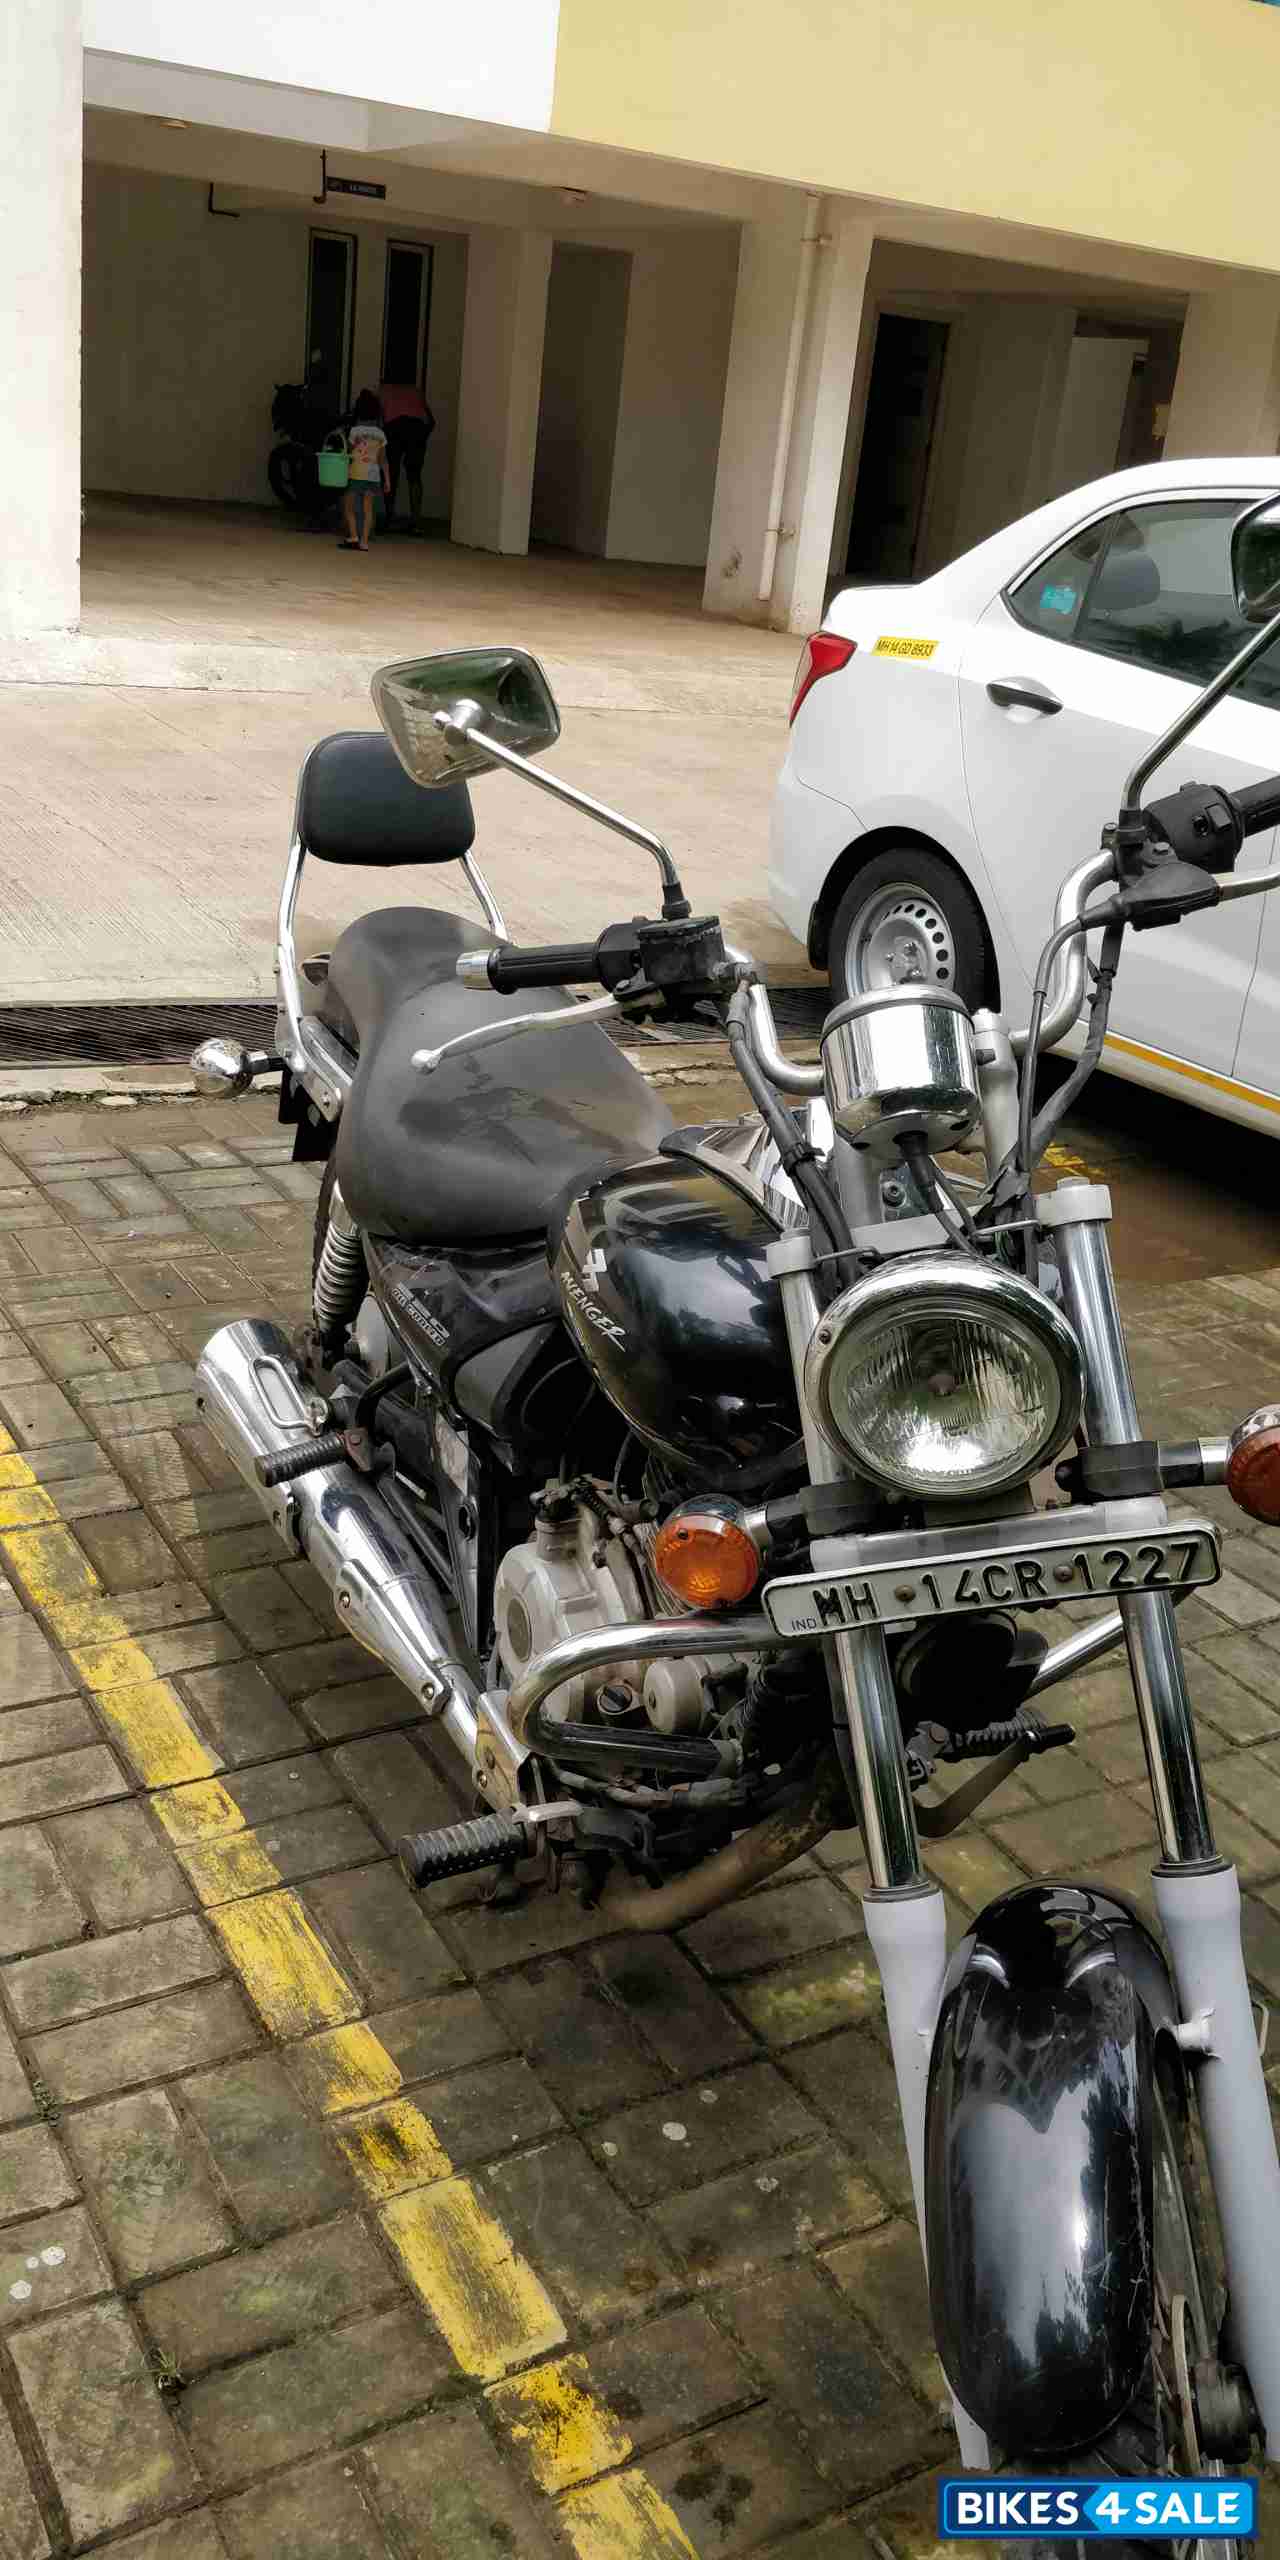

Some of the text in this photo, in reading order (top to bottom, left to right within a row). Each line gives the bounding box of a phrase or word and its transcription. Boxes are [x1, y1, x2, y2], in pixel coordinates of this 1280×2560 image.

[560, 1271, 626, 1353] AVENGER
[791, 1616, 817, 1631] IND
[812, 1541, 1199, 1627] MH 14CR 1227
